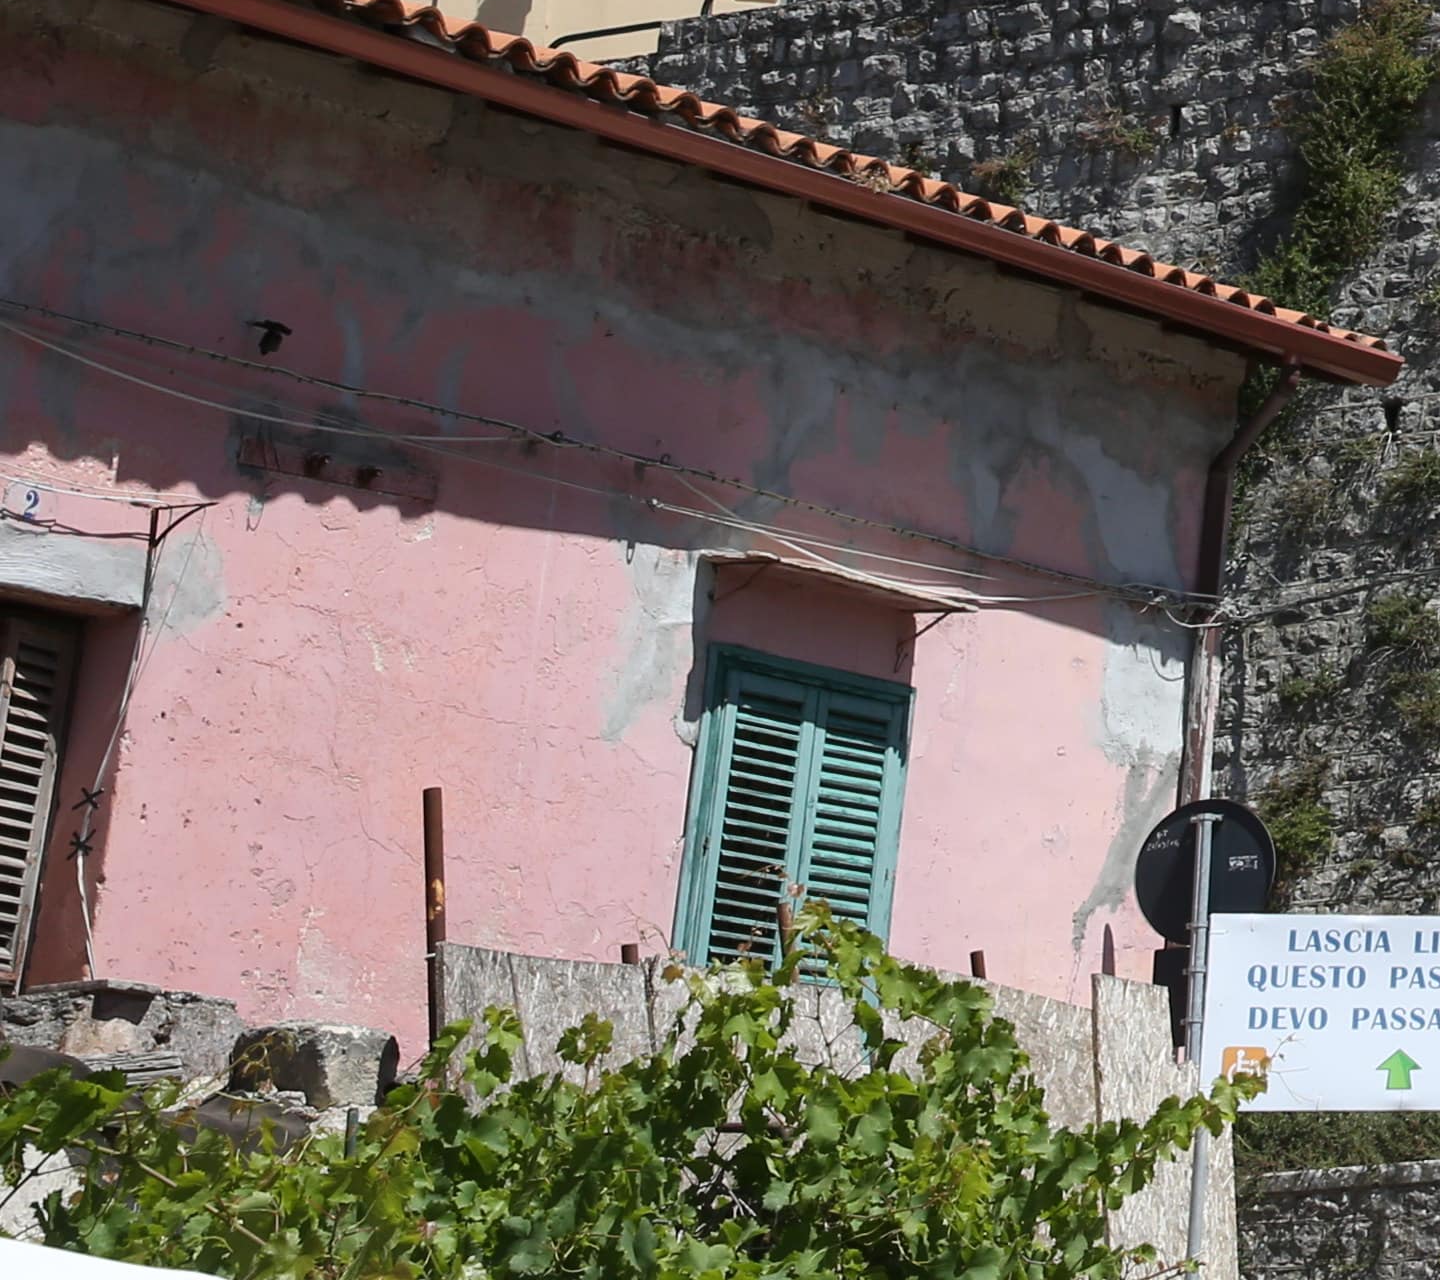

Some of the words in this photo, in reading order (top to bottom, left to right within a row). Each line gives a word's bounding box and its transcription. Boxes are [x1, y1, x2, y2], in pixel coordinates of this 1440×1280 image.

[24, 490, 41, 520] 2
[1288, 930, 1392, 953] LASCIA
[1246, 965, 1367, 991] QUESTO
[1247, 1006, 1328, 1031] DEVO
